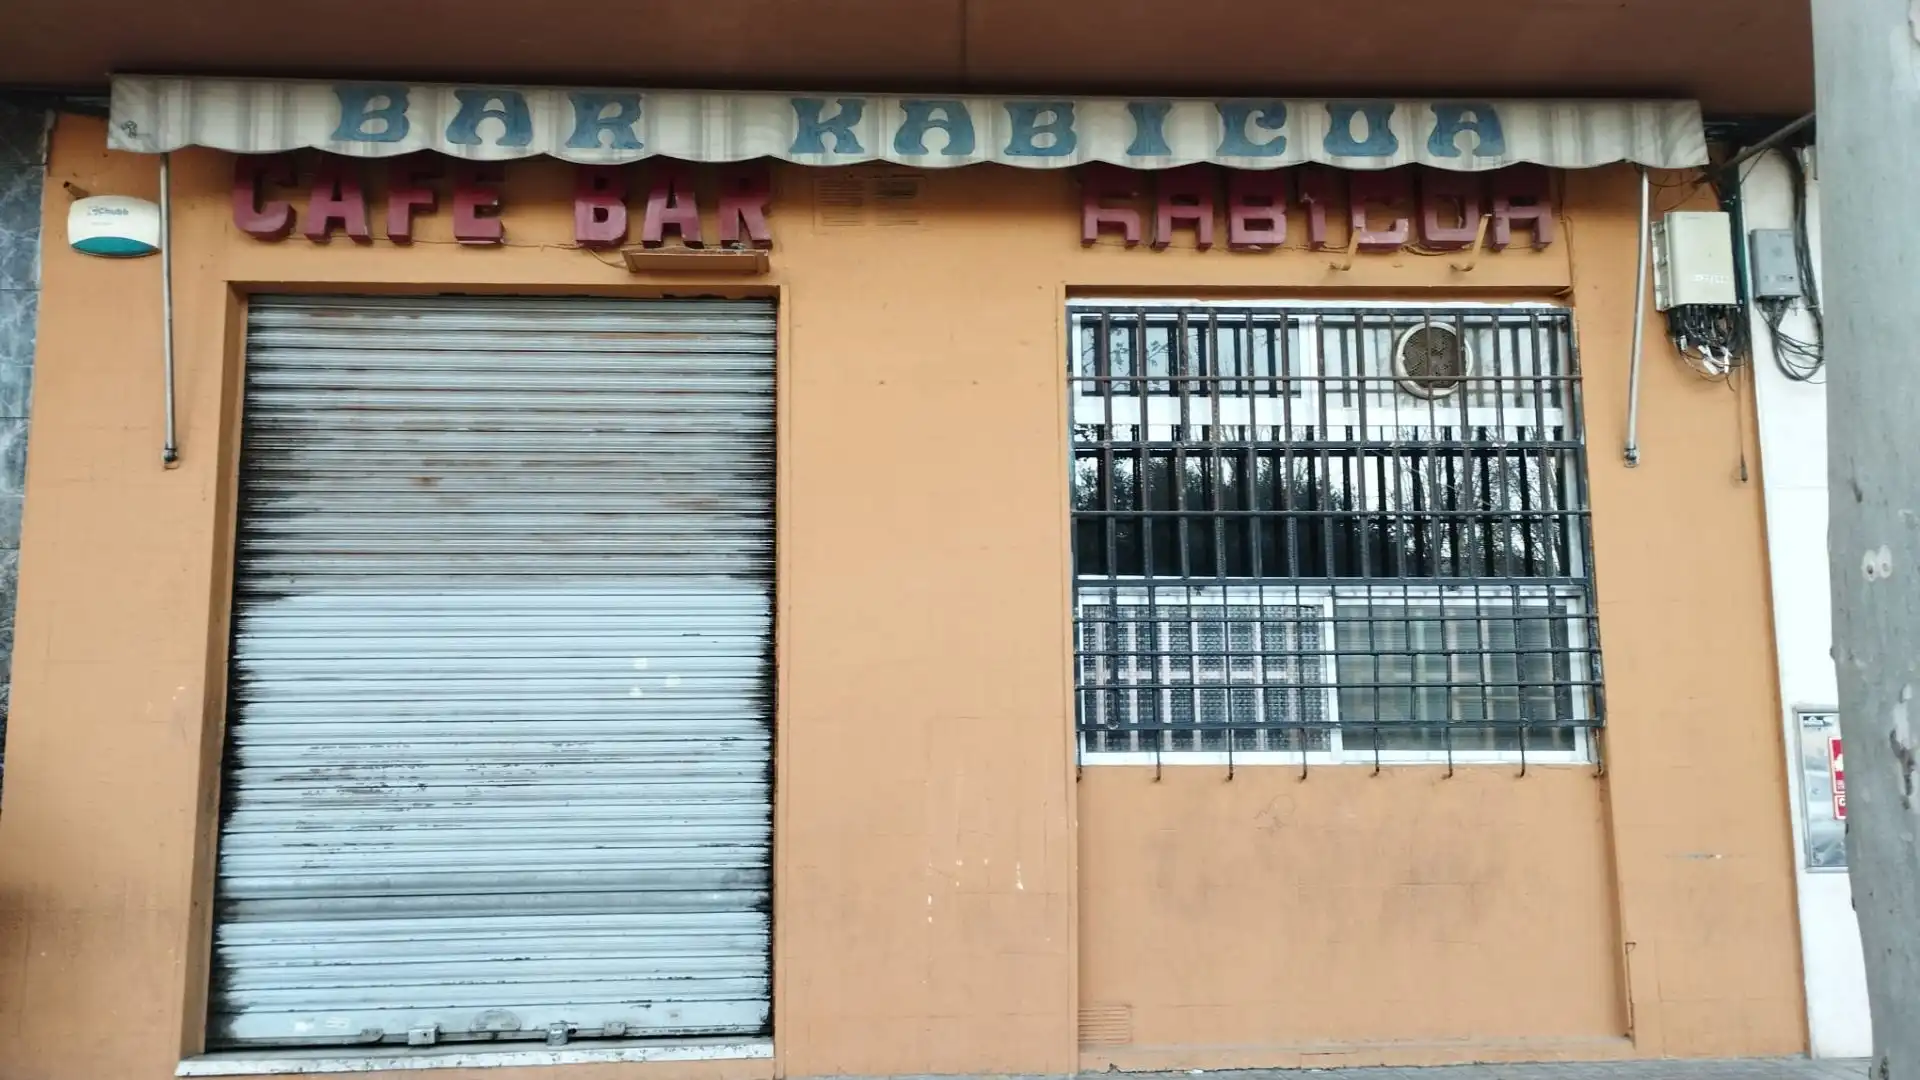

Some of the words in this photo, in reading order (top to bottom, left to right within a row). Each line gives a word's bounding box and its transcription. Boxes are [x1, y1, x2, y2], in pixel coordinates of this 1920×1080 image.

[331, 85, 645, 149] BAR
[788, 98, 1506, 158] KABICOA
[232, 153, 506, 246] CAFE
[574, 160, 773, 249] BAR
